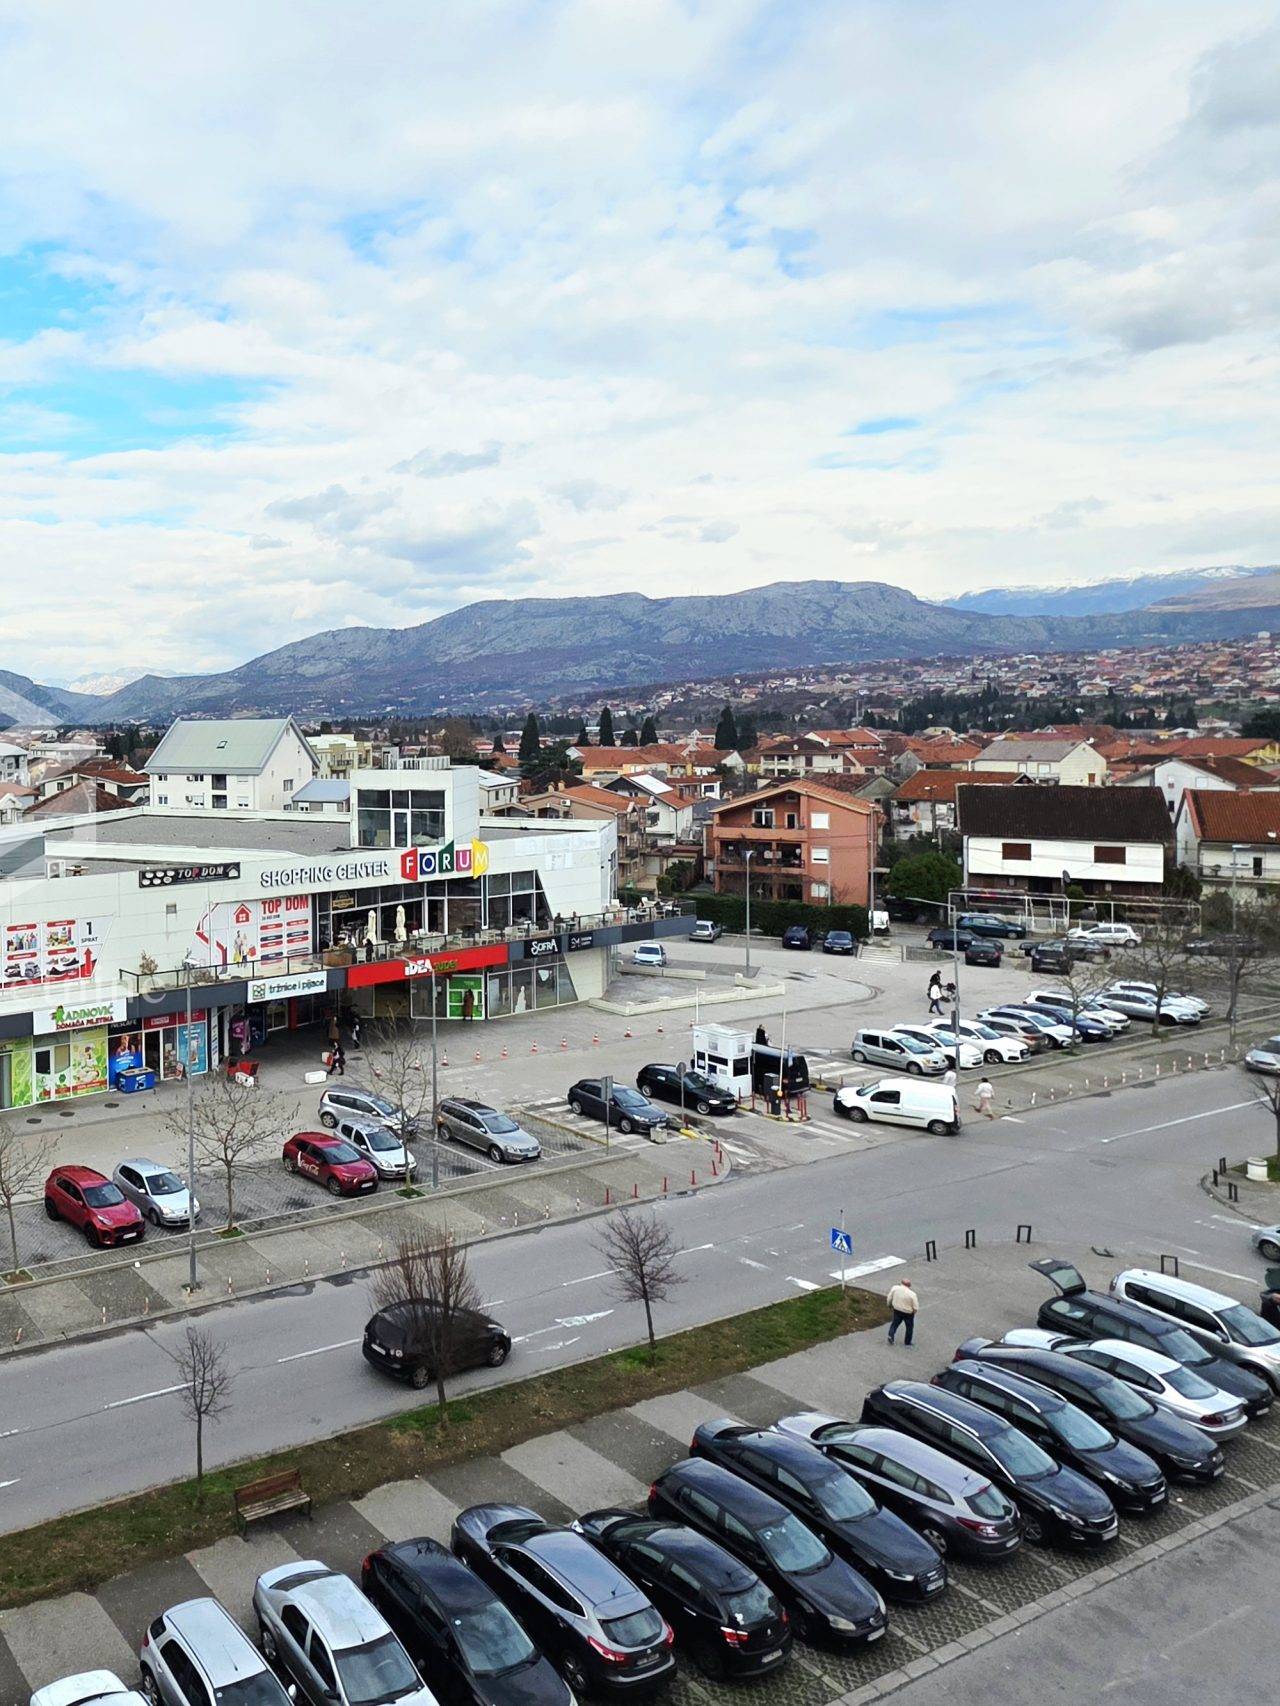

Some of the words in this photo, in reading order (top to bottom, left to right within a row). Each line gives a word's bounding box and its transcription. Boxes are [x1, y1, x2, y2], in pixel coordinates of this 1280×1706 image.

[178, 866, 200, 878] TOP
[201, 866, 224, 876] DOM
[404, 849, 488, 875] FORUM
[260, 866, 332, 888] SHOPPING
[336, 860, 389, 881] CENTER
[261, 898, 281, 915] TOP
[285, 895, 309, 911] DOM
[86, 921, 92, 935] 1
